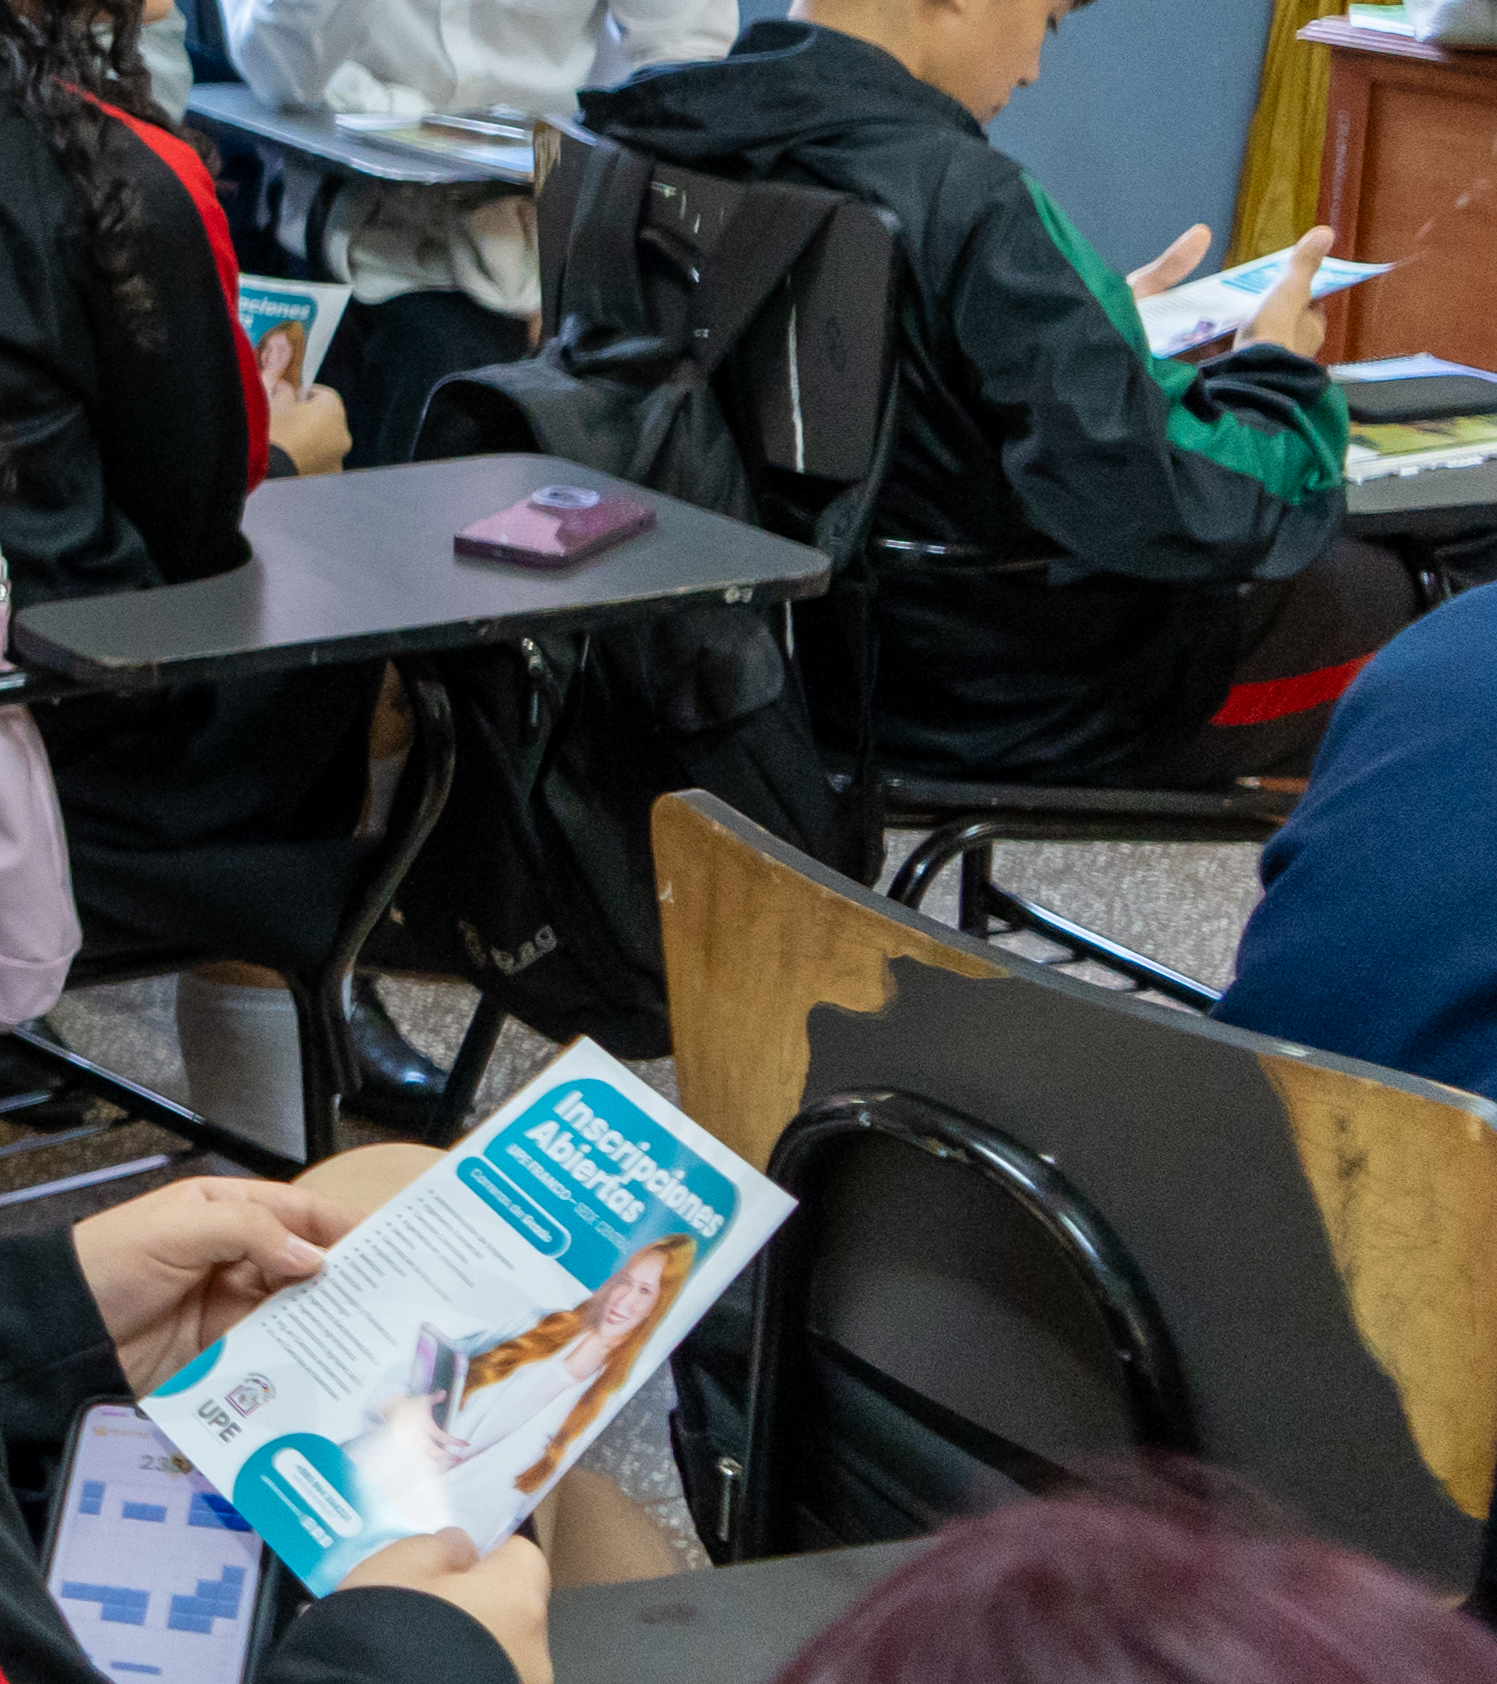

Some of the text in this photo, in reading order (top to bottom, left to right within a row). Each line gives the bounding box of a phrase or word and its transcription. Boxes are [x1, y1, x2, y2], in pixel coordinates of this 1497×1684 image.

[522, 1119, 646, 1225] Abiertas
[551, 1089, 727, 1239] Inscripciones
[197, 1399, 242, 1443] UPE
